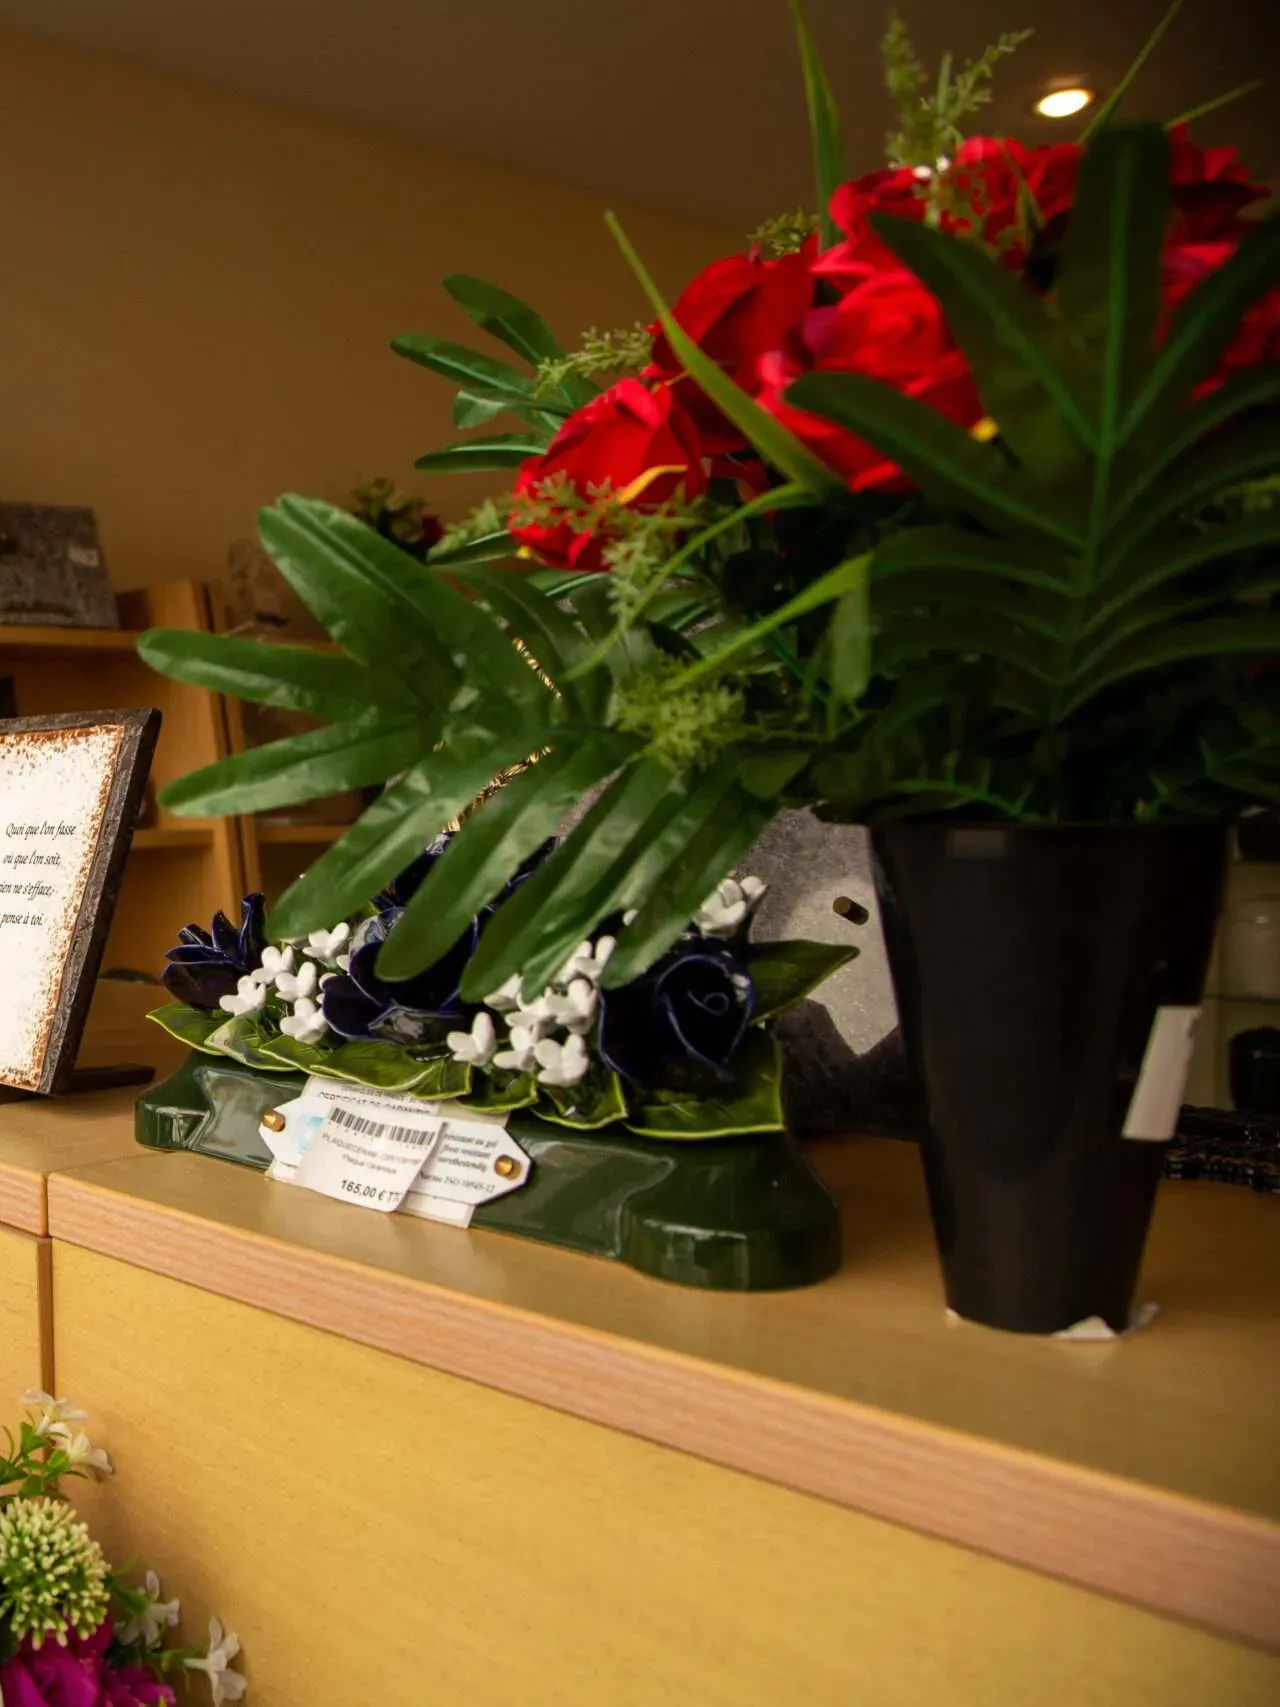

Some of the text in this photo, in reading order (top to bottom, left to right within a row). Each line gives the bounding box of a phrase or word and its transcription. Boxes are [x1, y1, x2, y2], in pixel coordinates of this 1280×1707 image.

[5, 822, 23, 838] Quoi
[23, 824, 40, 841] que
[51, 820, 77, 841] fasse
[13, 853, 29, 870] que
[12, 883, 24, 894] ne
[341, 1179, 377, 1199] 165,00
[377, 1188, 387, 1201] €
